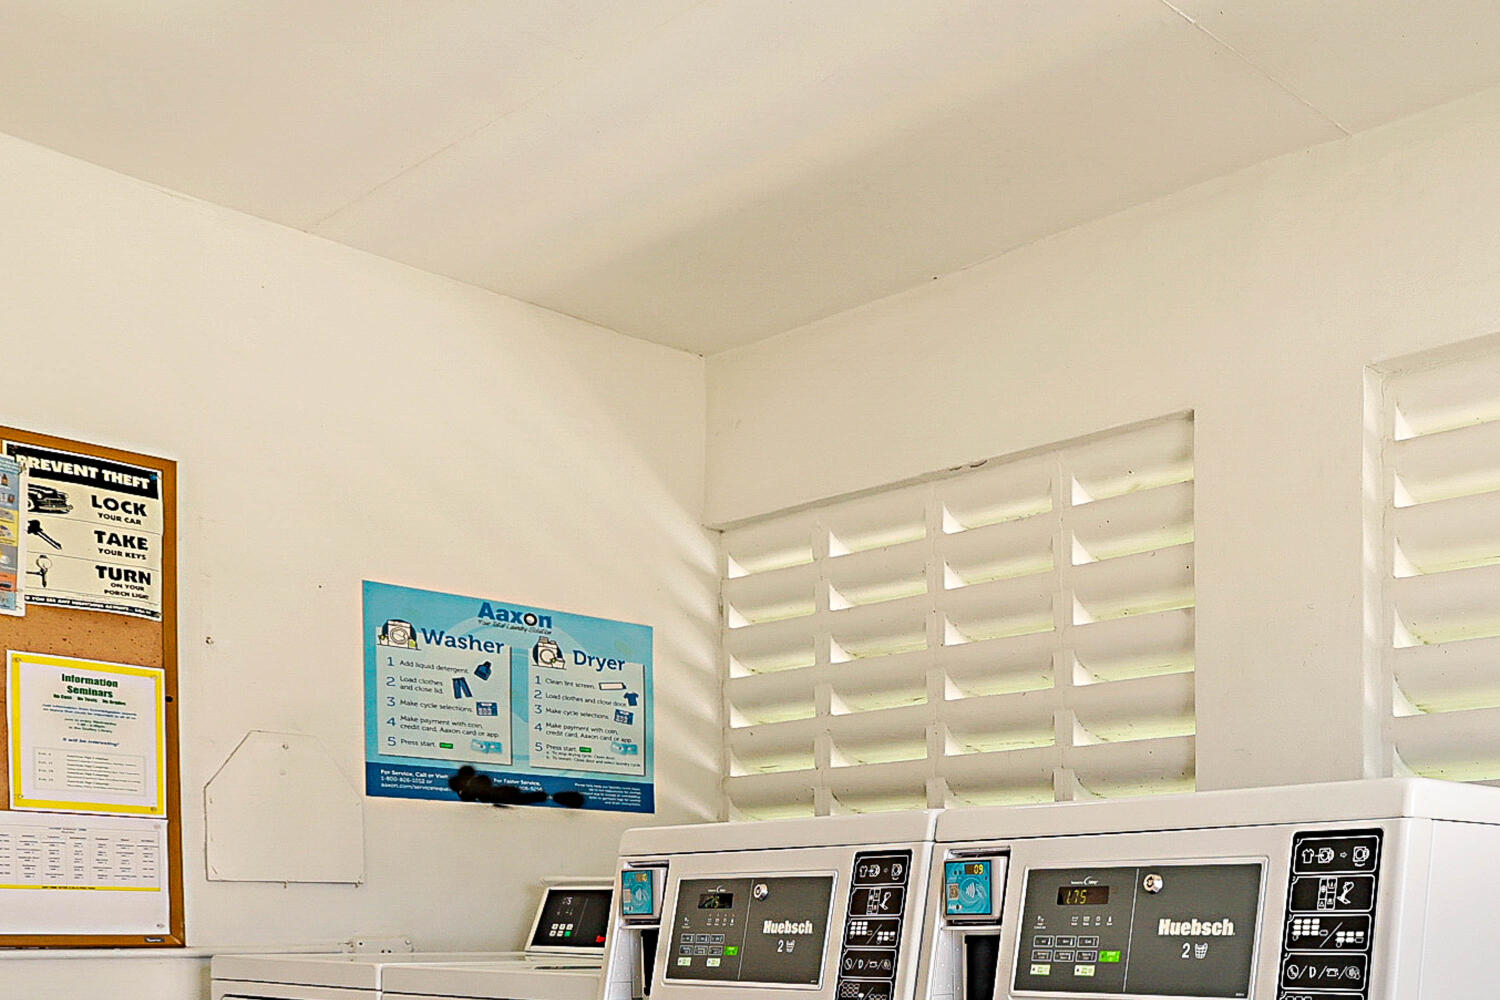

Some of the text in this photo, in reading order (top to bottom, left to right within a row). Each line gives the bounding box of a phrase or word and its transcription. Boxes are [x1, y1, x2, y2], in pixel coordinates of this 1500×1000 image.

[16, 454, 99, 479] PREVENT
[102, 469, 150, 489] THEFT
[91, 495, 147, 516] LOCK
[98, 512, 142, 526] YOUR CAR
[94, 530, 148, 551] TAKE
[98, 548, 146, 560] YOUR KEYS
[95, 565, 151, 585] TURN
[104, 589, 129, 598] PORCH
[124, 584, 145, 592] YOUR
[478, 602, 552, 628] Aaxon
[420, 628, 504, 654] Washer
[386, 656, 394, 667] 1
[415, 661, 435, 670] liquid
[573, 649, 626, 672] Dryer
[61, 673, 118, 688] Information
[386, 675, 443, 687] 2 Load clothes
[535, 675, 541, 684] 1
[66, 685, 113, 698] Seminars
[414, 685, 432, 693] close
[387, 696, 396, 707] 3
[400, 699, 418, 707] Make
[419, 700, 438, 710] cycle
[534, 690, 542, 699] 2
[562, 695, 583, 703] clothes
[534, 704, 542, 714] 3
[563, 709, 578, 717] cycle
[386, 717, 395, 727] 4
[400, 715, 418, 723] Make
[420, 717, 449, 727] payment
[534, 723, 542, 732] 4
[563, 724, 589, 732] payment
[439, 726, 461, 735] Aaxon
[462, 729, 477, 737] card
[387, 736, 397, 747] 5
[400, 738, 419, 746] Press
[535, 742, 543, 752] 5
[546, 743, 562, 751] Press
[974, 863, 984, 875] 09
[762, 920, 813, 934] Huebsch
[1158, 918, 1234, 936] Huebsch
[777, 940, 784, 953] 2
[1181, 942, 1190, 959] 2
